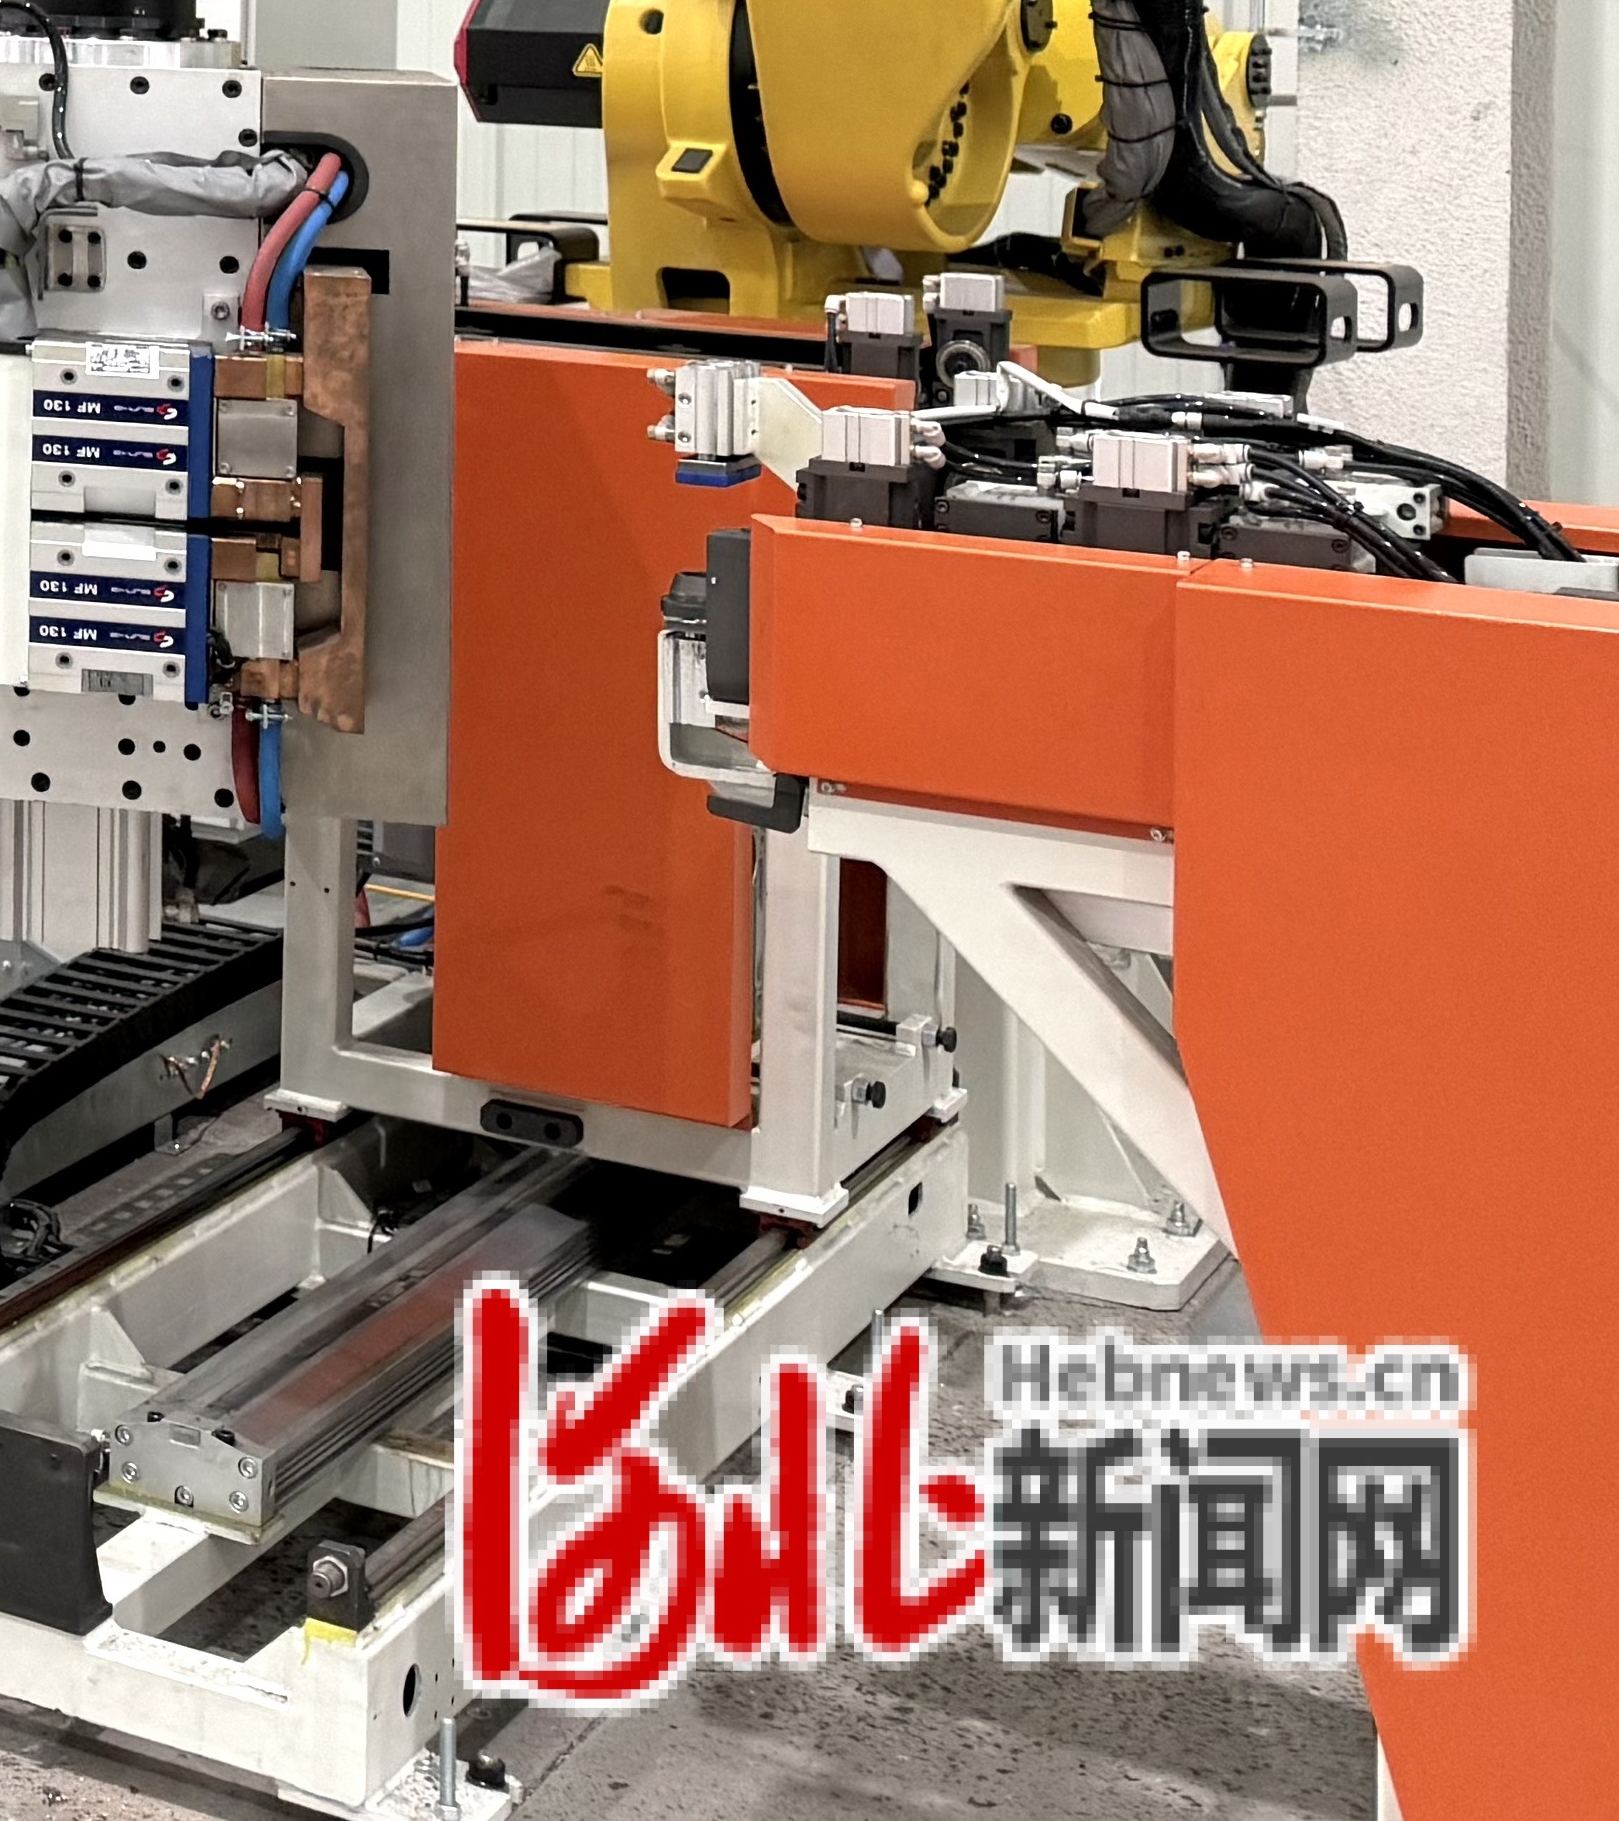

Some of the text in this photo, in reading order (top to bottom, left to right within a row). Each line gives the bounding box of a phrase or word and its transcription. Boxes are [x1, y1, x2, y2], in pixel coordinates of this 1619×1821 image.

[43, 398, 71, 413] 130
[76, 401, 101, 415] MF
[42, 443, 70, 457] 130
[76, 445, 101, 459] MF
[39, 579, 68, 593] 130
[73, 582, 98, 596] MF
[38, 625, 67, 638] 130
[72, 627, 97, 641] MF
